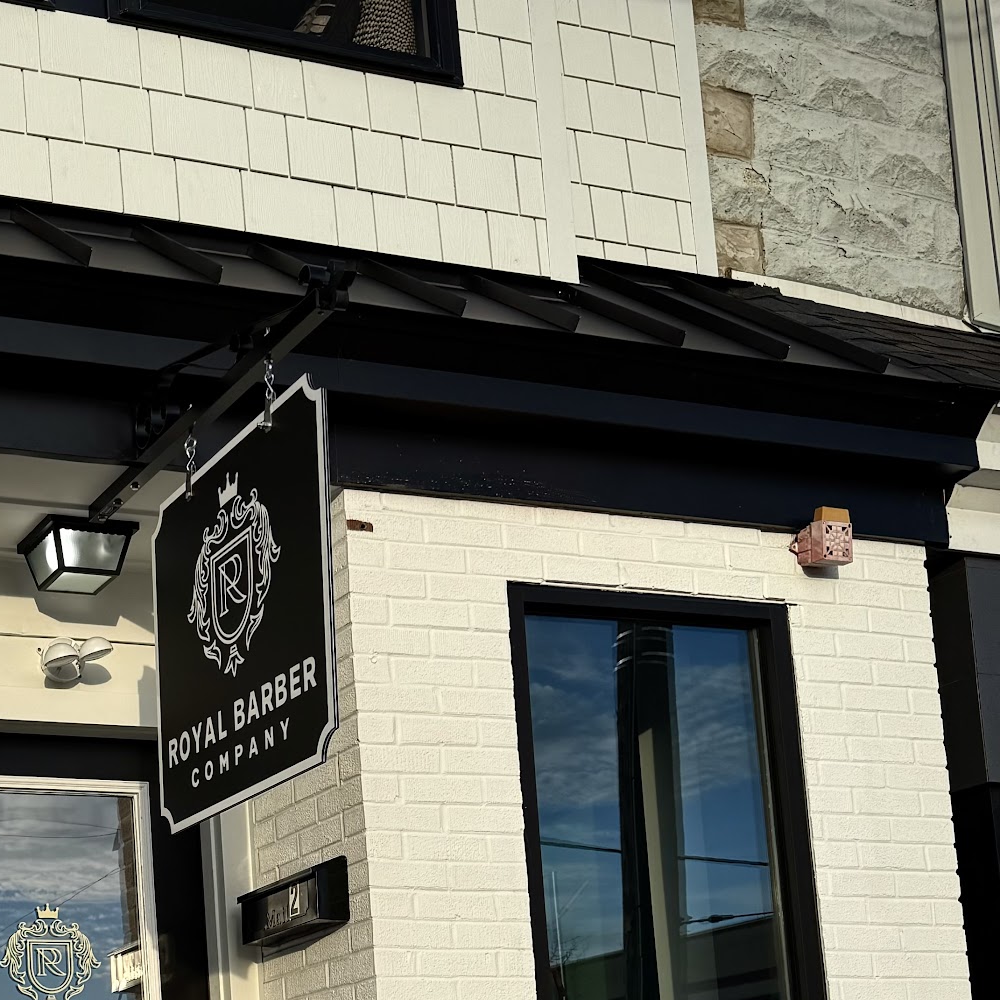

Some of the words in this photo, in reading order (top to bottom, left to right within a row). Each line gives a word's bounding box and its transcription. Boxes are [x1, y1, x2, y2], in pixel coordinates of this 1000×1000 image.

[168, 710, 228, 769] ROYAL
[233, 656, 317, 732] BARBER
[191, 717, 290, 788] COMPANY
[289, 885, 299, 916] 2
